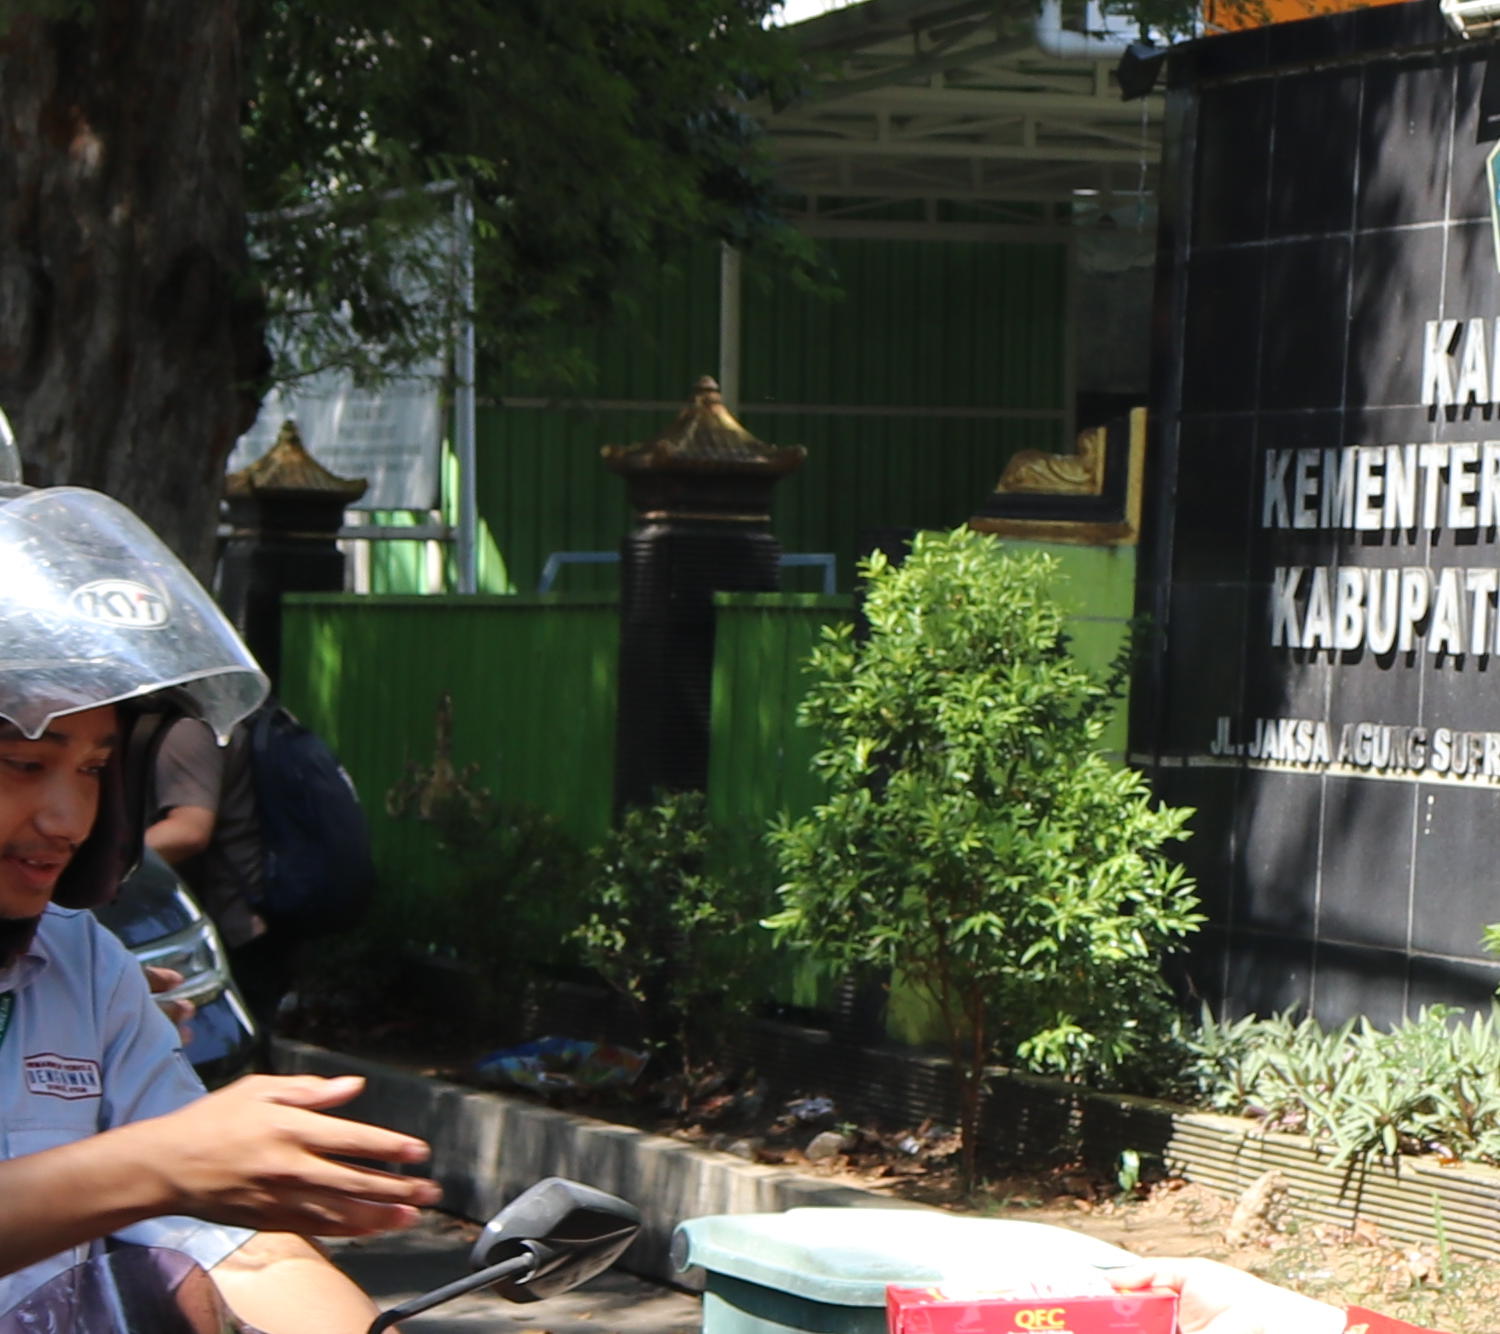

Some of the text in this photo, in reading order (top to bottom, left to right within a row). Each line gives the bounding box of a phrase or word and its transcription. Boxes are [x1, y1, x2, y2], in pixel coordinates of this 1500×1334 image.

[1210, 716, 1243, 755] JL.
[1249, 717, 1330, 763] JAKSA
[1338, 723, 1428, 770] AGUNG
[1014, 1308, 1066, 1330] QFC
